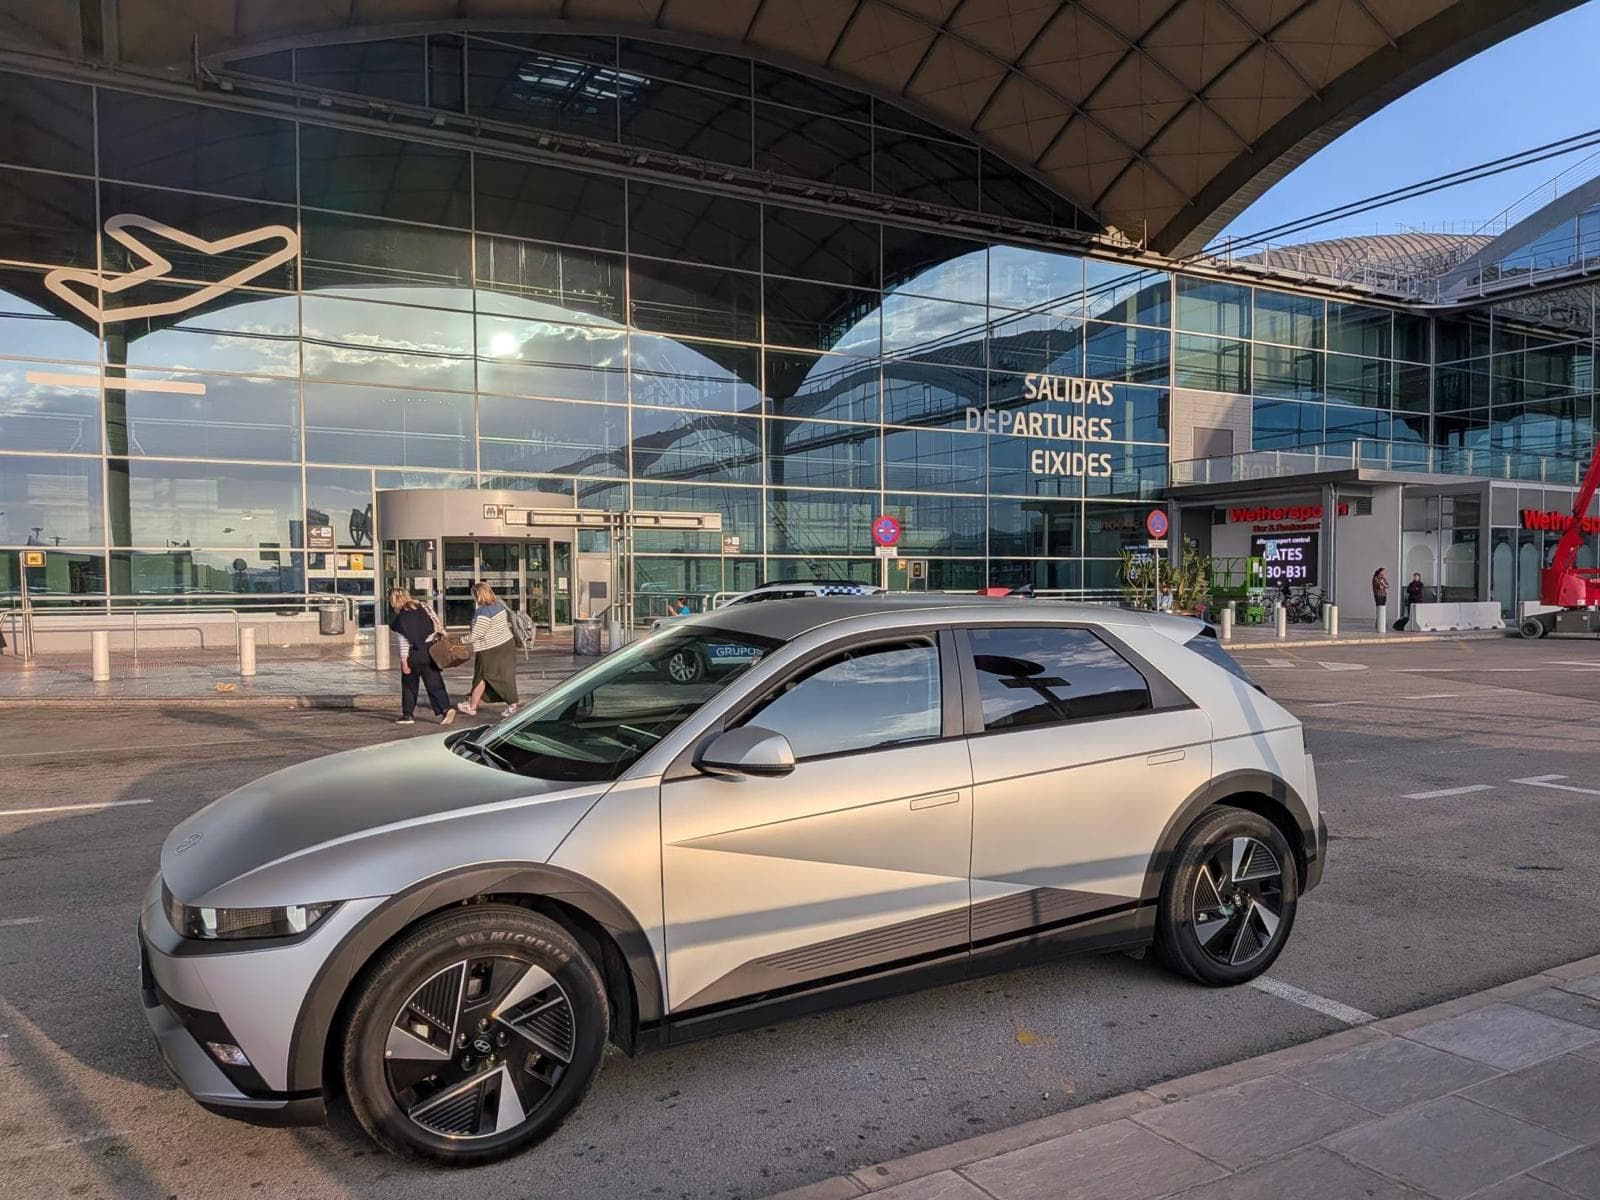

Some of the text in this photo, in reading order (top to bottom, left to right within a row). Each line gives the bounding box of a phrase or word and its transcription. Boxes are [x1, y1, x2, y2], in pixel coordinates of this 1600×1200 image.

[1024, 373, 1114, 406] SALIDAS
[966, 407, 1112, 442] DEPARTURES
[1032, 449, 1112, 477] EIXIDES
[1231, 503, 1349, 523] Wetherspon
[428, 541, 434, 550] 1
[1259, 565, 1307, 578] 30-B31
[490, 931, 570, 962] MICHELIN
